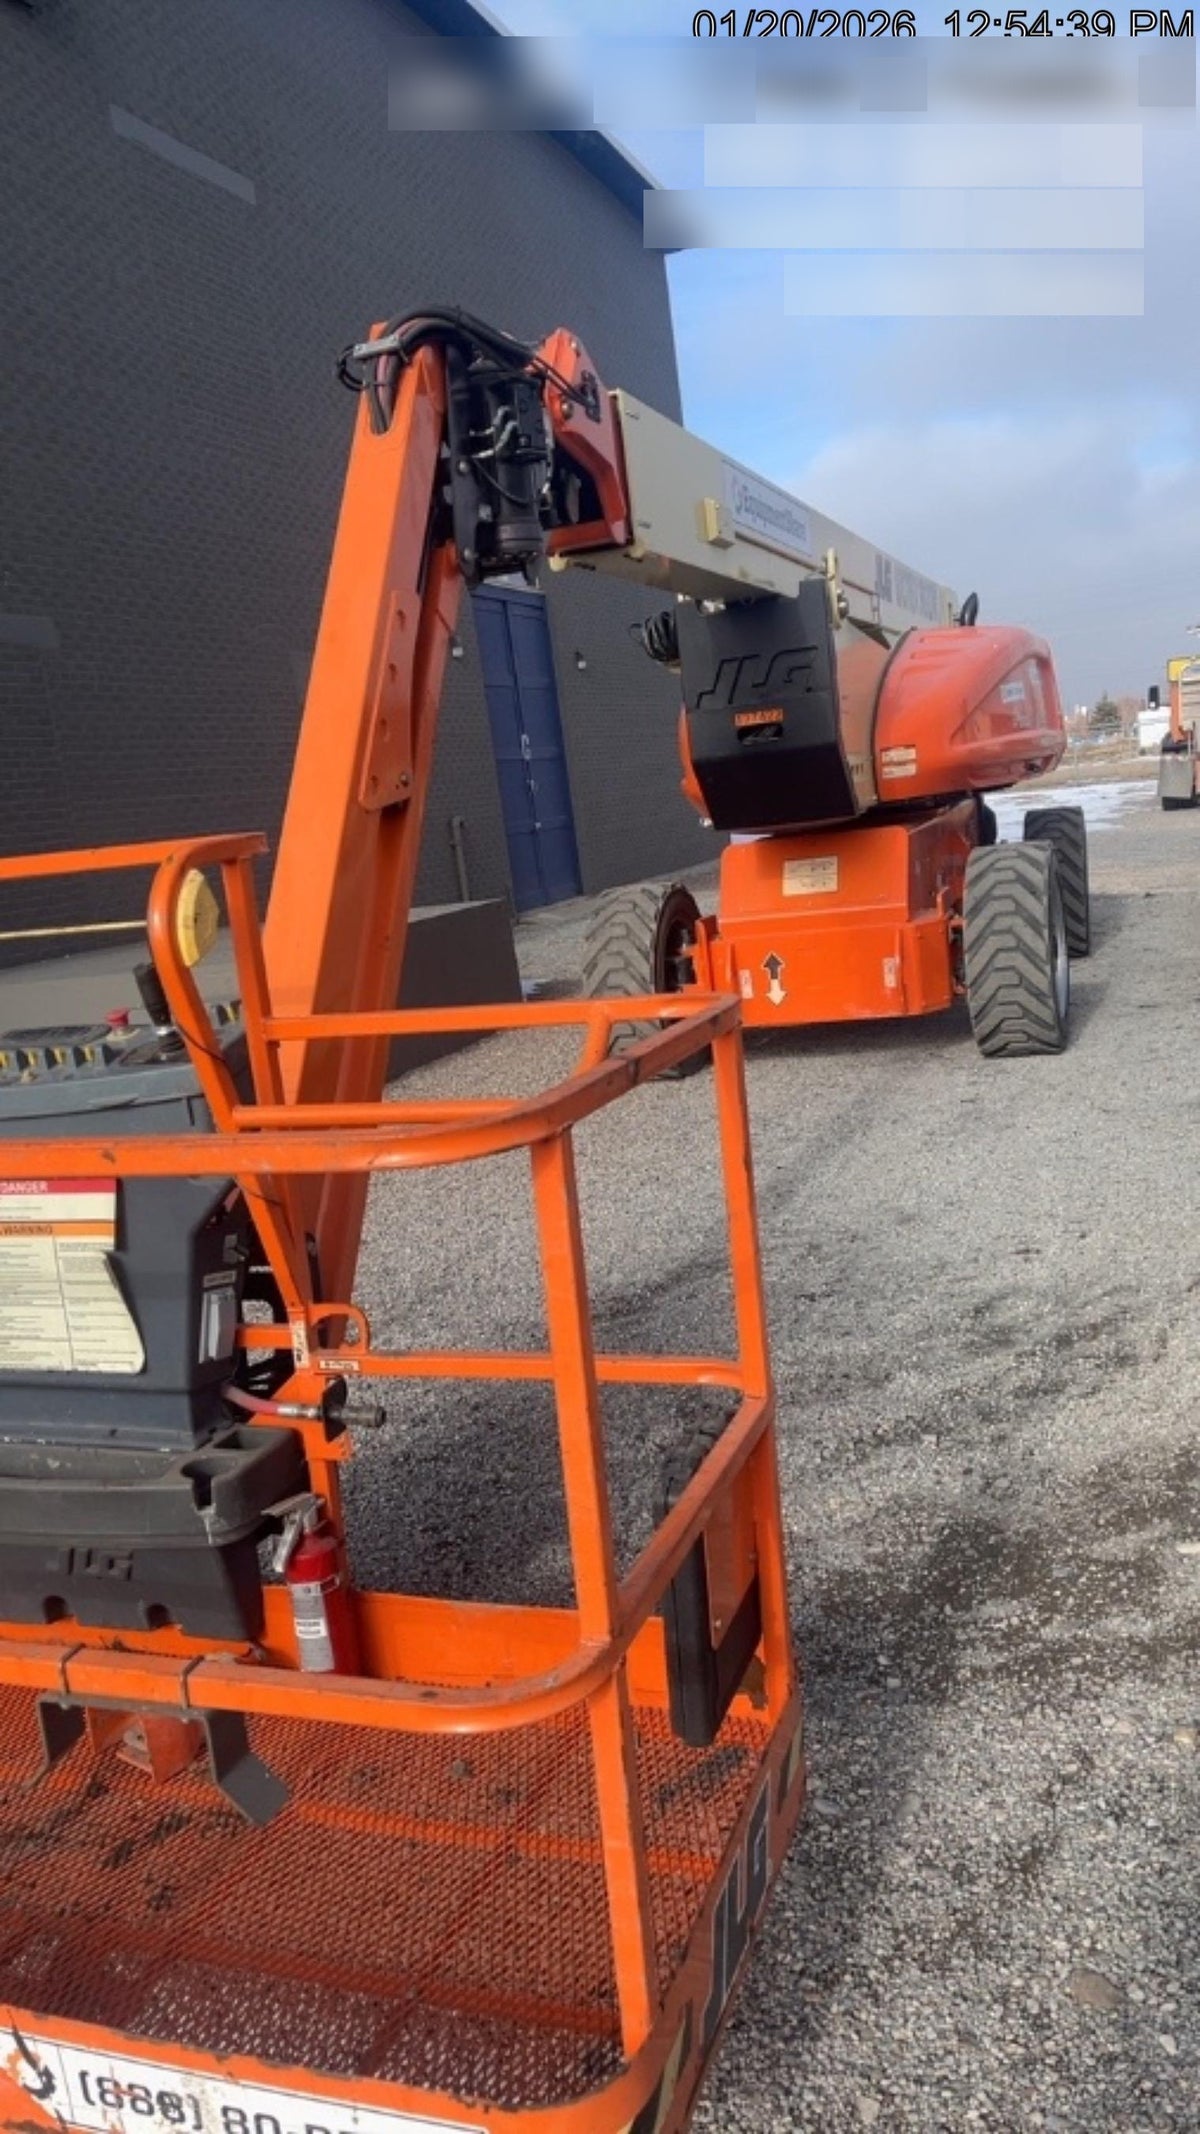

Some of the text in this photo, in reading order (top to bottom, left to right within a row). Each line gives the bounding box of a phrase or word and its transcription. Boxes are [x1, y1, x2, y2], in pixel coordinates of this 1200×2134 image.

[696, 645, 820, 709] JLG
[703, 1772, 773, 2047] JLG
[221, 2105, 358, 2134] 80-
